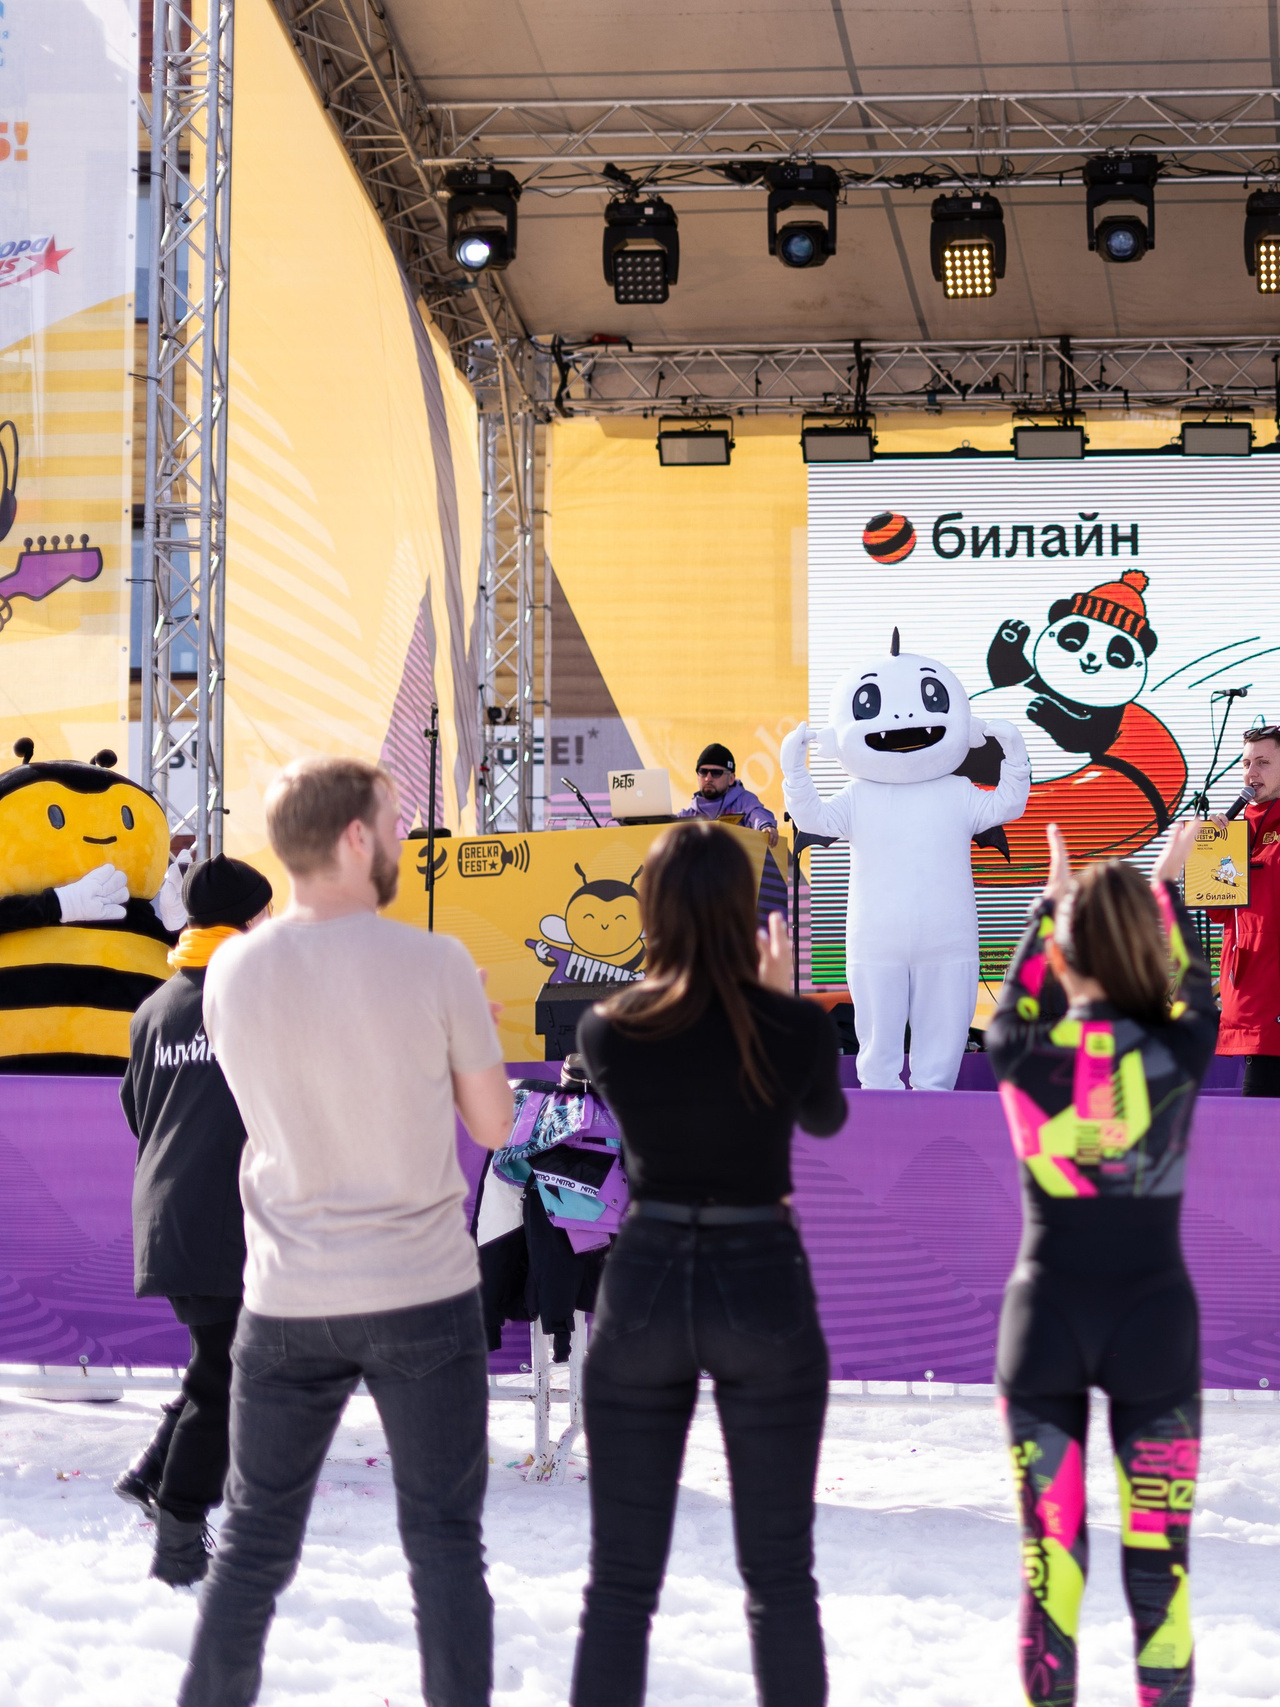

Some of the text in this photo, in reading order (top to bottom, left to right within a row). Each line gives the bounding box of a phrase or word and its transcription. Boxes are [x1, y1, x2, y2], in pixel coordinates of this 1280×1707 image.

[932, 511, 1139, 560] билайн
[464, 845, 499, 859] GRELKA
[464, 860, 488, 873] FEST
[1205, 893, 1237, 901] билайн
[555, 1178, 576, 1189] NITRO
